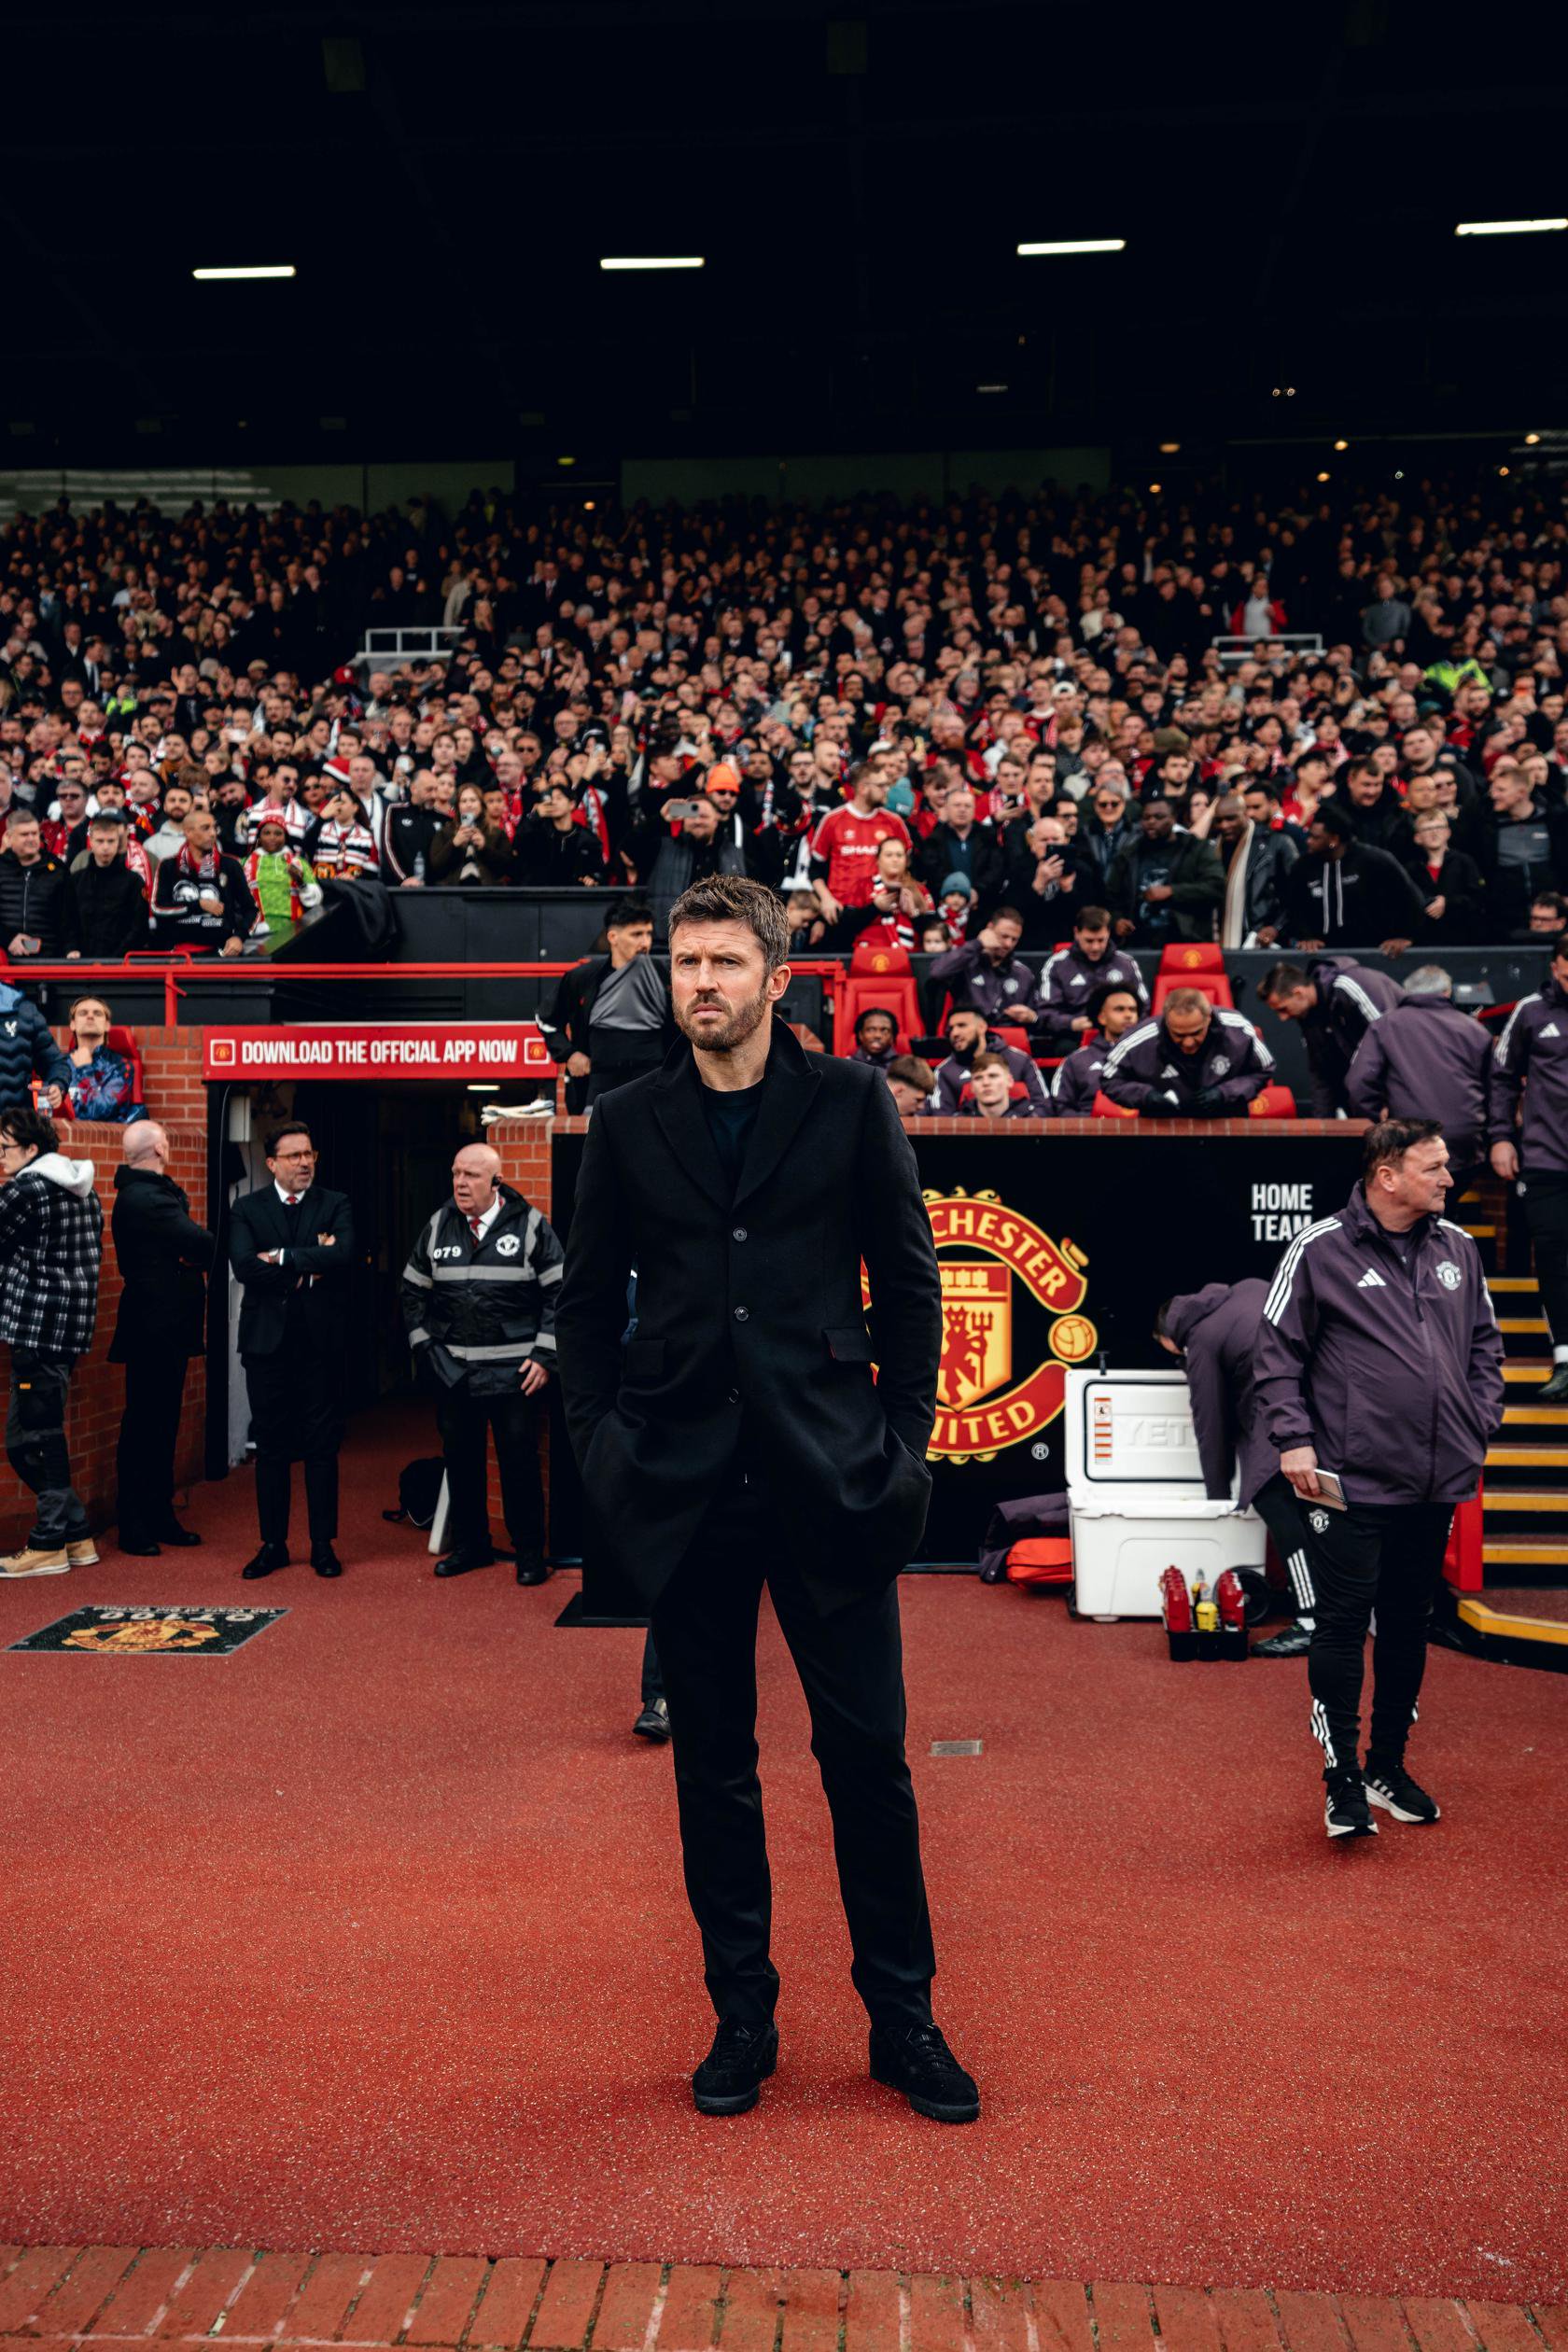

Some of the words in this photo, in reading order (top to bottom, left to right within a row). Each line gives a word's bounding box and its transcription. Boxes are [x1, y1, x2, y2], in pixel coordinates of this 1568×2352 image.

[841, 846, 878, 856] SHAR
[242, 1041, 332, 1064] DOWNLOAD
[335, 1040, 368, 1064] THE
[371, 1040, 441, 1064] OFFICIAL
[443, 1040, 476, 1063] APP
[479, 1039, 518, 1063] NOW
[1252, 1183, 1313, 1211] HOME
[433, 1245, 463, 1260] 079
[929, 1209, 1068, 1297] CHESTER
[931, 1400, 1035, 1445] ITED
[1118, 1419, 1195, 1447] YET
[99, 1611, 255, 1622] OT100
